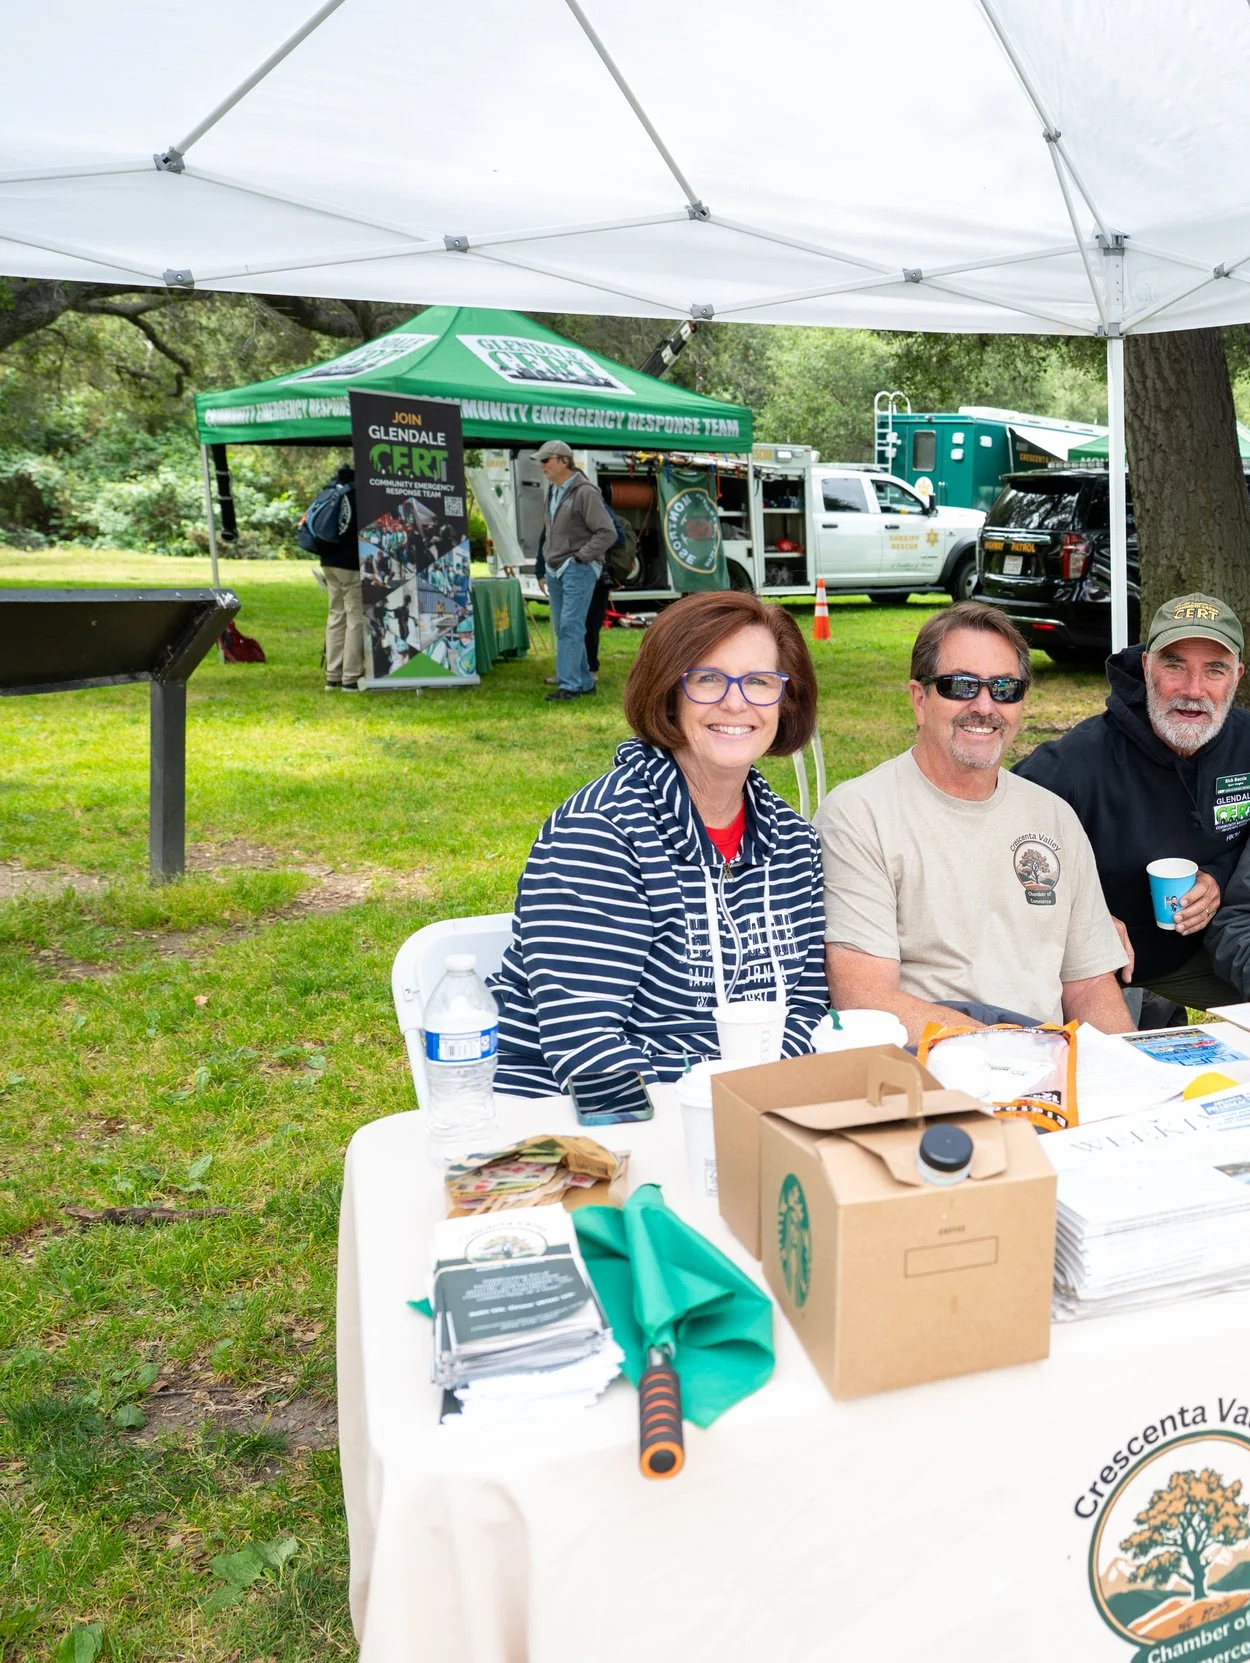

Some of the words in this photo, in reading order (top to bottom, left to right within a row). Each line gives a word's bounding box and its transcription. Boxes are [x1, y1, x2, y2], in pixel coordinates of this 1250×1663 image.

[309, 397, 351, 418] RESPONS
[440, 398, 528, 423] MUNITY
[532, 405, 625, 429] EMERGENCY
[627, 411, 701, 435] RESPONSE
[702, 418, 739, 438] TEAM
[392, 411, 422, 426] JOIN
[368, 425, 446, 446] GLENDALE
[369, 444, 449, 478] CERT
[369, 478, 413, 489] COMMUNITY
[414, 481, 455, 492] EMERGENCY
[386, 487, 421, 497] RESPONSE
[422, 490, 442, 499] TEAM
[1174, 608, 1218, 621] CERT
[1010, 833, 1037, 852] Crescenta
[1039, 833, 1061, 852] Valley
[1074, 1402, 1209, 1522] Crescenta
[1147, 1621, 1231, 1663] Chamber
